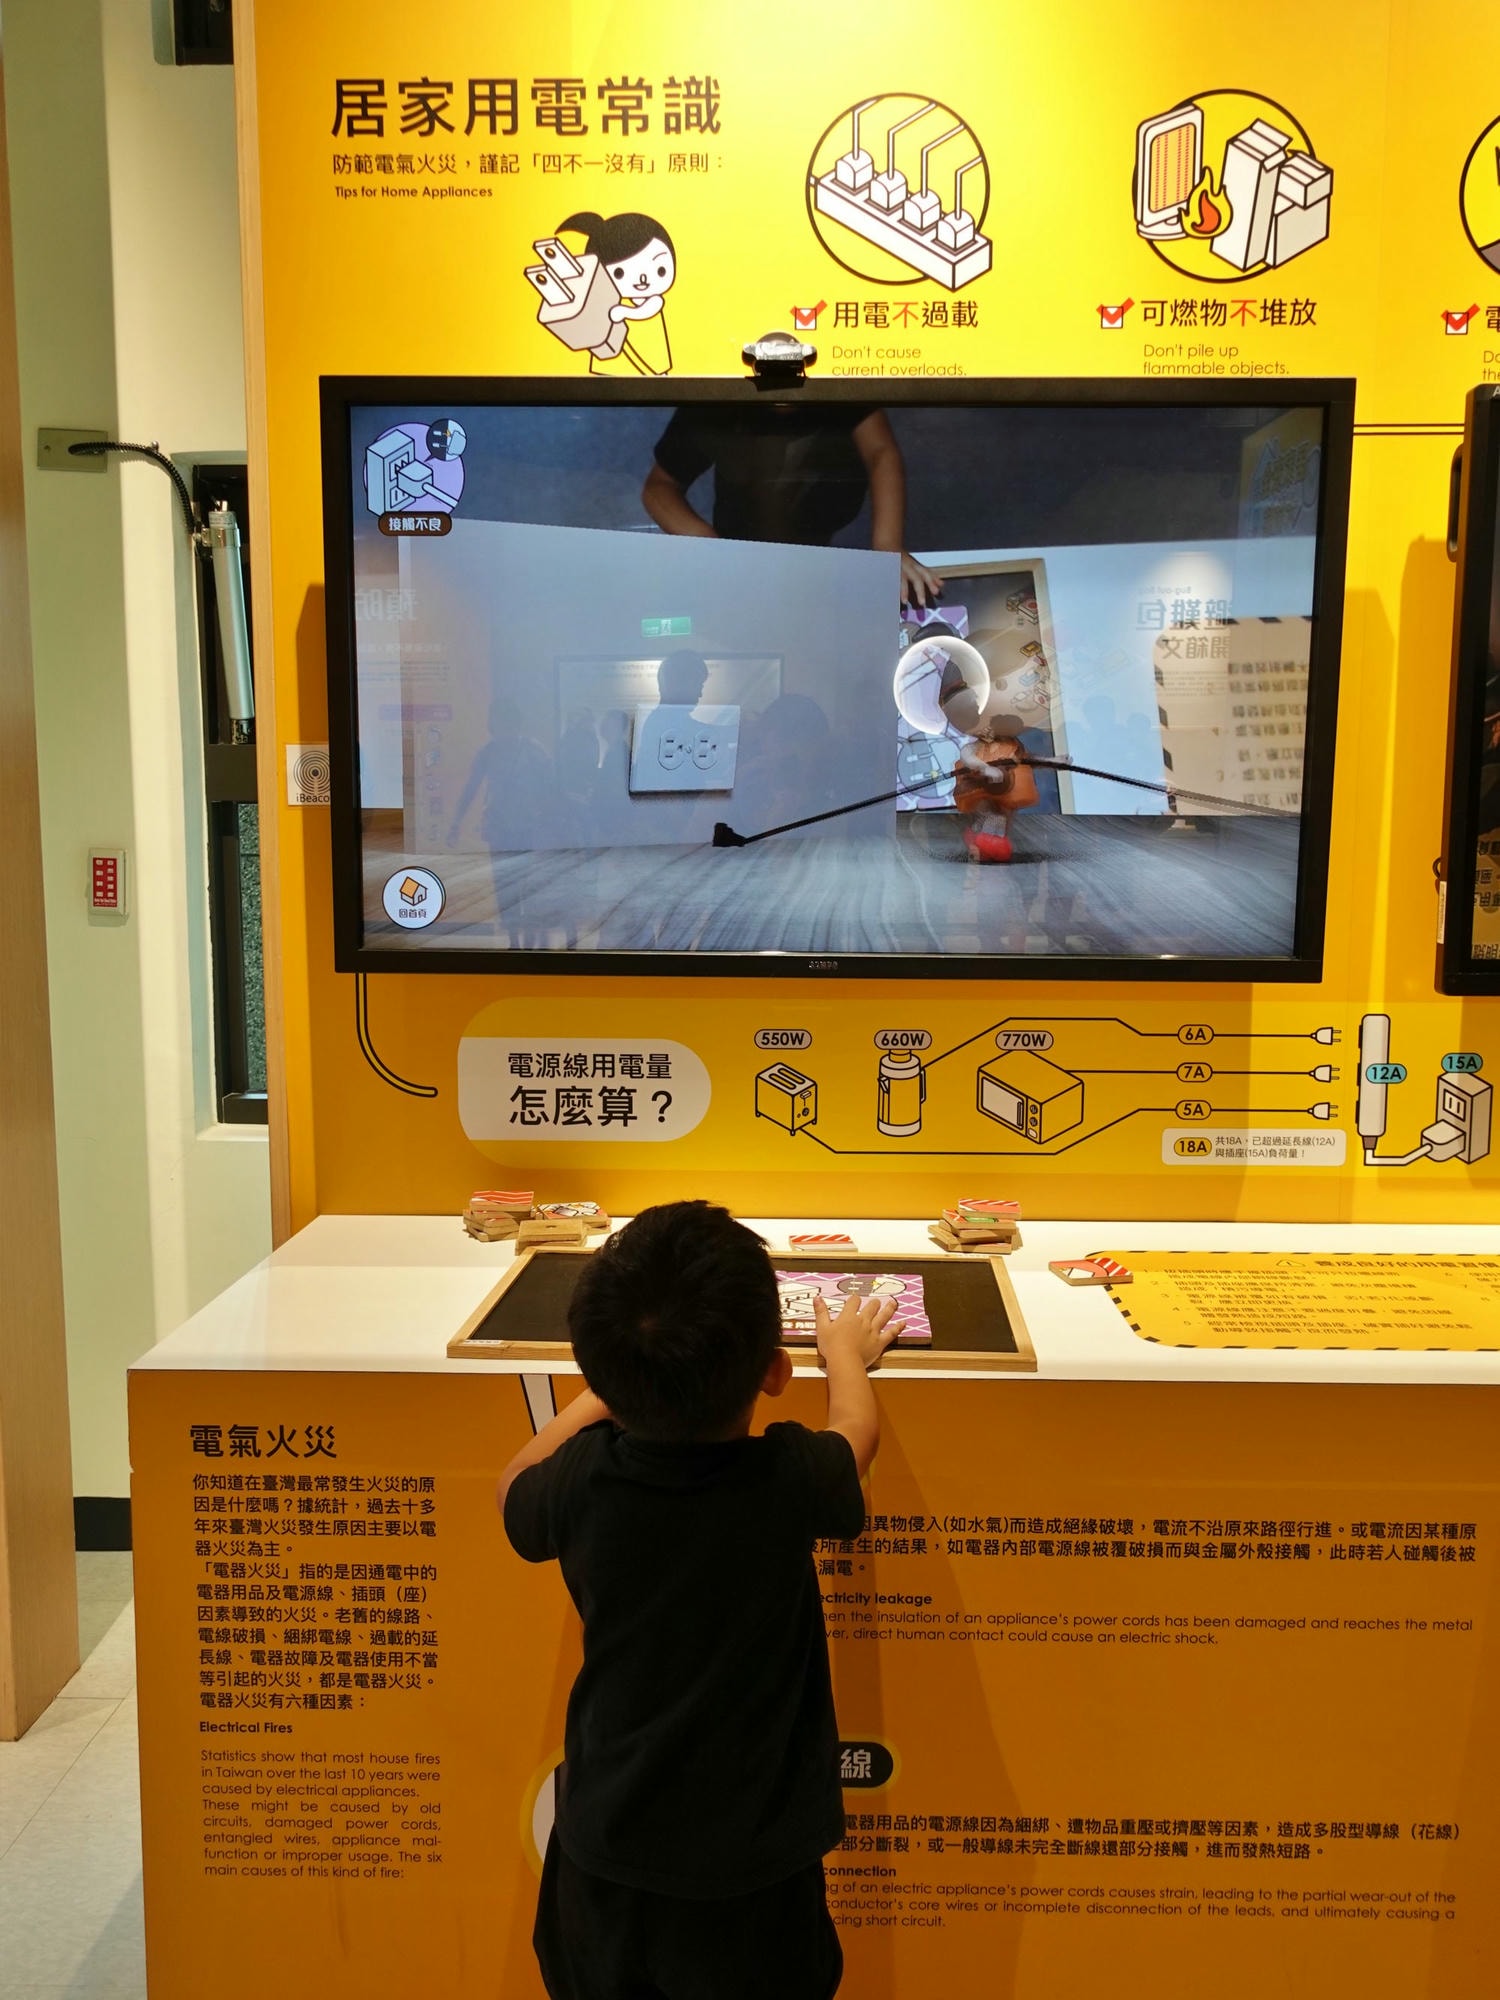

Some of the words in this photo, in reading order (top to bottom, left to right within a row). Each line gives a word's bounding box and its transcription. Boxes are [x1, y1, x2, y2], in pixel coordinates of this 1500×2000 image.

[331, 75, 721, 138] 居家用電常識
[332, 153, 723, 176] 防範電氣火災，謹記「四不一沒有」原則：
[335, 186, 358, 199] Tips
[361, 186, 377, 197] for
[381, 186, 418, 197] Home
[422, 186, 492, 200] Appliances
[833, 300, 979, 329] 用電不過載
[1141, 298, 1317, 327] 可燃物不堆放
[833, 345, 870, 359] Don't
[876, 348, 921, 359] cause
[1144, 344, 1183, 357] Don't
[1188, 344, 1214, 359] pile
[1219, 347, 1238, 359] up
[832, 364, 885, 376] current
[890, 364, 966, 376] overloads.
[1144, 361, 1225, 375] flammable
[1230, 361, 1289, 377] objects.
[388, 517, 441, 531] 接觸不良
[399, 908, 427, 918] 回首頁
[761, 1032, 804, 1046] 550W
[881, 1033, 924, 1047] 660W
[1003, 1034, 1046, 1047] 770W
[1185, 1028, 1207, 1041] 6A
[507, 1053, 672, 1080] 電源線用電量
[1446, 1056, 1478, 1069] 15A
[1184, 1066, 1205, 1079] 7A
[1371, 1067, 1402, 1080] 12A
[509, 1085, 674, 1127] 怎麼算？
[1183, 1104, 1204, 1117] 5A
[1179, 1141, 1208, 1153] 18A
[190, 1424, 337, 1458] 電氣火災
[193, 1474, 435, 1493] 你知道在臺灣最常發生火災的原
[194, 1496, 435, 1514] 因是什麼嗎？據統計，過去十多
[194, 1518, 436, 1537] 年來臺灣火災發生原因主要以電
[195, 1541, 293, 1557] 器火災為主。
[204, 1562, 437, 1581] 「電器火災」指的是因通電中的
[197, 1584, 428, 1603] 電器用品及電源線、插頭（座）
[874, 1592, 933, 1607] leakage
[198, 1606, 432, 1624] 因素導致的火災。老舊的線路、
[850, 1611, 873, 1623] the
[877, 1611, 940, 1623] insulation
[945, 1612, 959, 1624] of
[964, 1615, 982, 1624] an
[1073, 1616, 1117, 1629] power
[1122, 1614, 1160, 1626] cords
[1165, 1615, 1189, 1627] has
[1193, 1615, 1230, 1627] been
[1235, 1616, 1306, 1632] damaged
[1311, 1617, 1339, 1629] and
[1344, 1617, 1399, 1630] reaches
[1405, 1618, 1427, 1630] the
[1432, 1618, 1473, 1631] metal
[198, 1628, 438, 1646] 電線破損、綑綁電線、過載的延
[853, 1628, 892, 1640] direct
[896, 1629, 945, 1641] human
[949, 1629, 1004, 1642] contact
[1008, 1630, 1047, 1642] could
[1051, 1633, 1093, 1643] cause
[1097, 1634, 1115, 1643] an
[1120, 1631, 1171, 1644] electric
[1175, 1632, 1218, 1644] shock.
[199, 1650, 438, 1668] 長線、電器故障及電器使用不當
[200, 1671, 434, 1689] 等引起的火災，都是電器火災。
[200, 1693, 365, 1710] 電器火災有六種因素：
[200, 1721, 260, 1733] Electrical
[264, 1722, 292, 1733] Fires
[200, 1750, 256, 1762] Statistics
[260, 1750, 295, 1762] show
[300, 1751, 327, 1763] that
[332, 1752, 364, 1763] most
[369, 1752, 409, 1764] house
[415, 1753, 440, 1765] fires
[841, 1749, 871, 1779] 線
[201, 1766, 213, 1778] in
[216, 1766, 263, 1778] Taiwan
[266, 1770, 296, 1779] over
[300, 1767, 320, 1779] the
[324, 1768, 346, 1779] last
[351, 1768, 365, 1780] 10
[368, 1771, 404, 1784] years
[407, 1772, 440, 1781] were
[202, 1782, 251, 1795] caused
[256, 1783, 272, 1798] by
[276, 1784, 338, 1796] electrical
[342, 1784, 419, 1800] appliances.
[203, 1799, 240, 1811] These
[251, 1800, 288, 1815] might
[300, 1800, 318, 1812] be
[330, 1801, 380, 1813] caused
[392, 1802, 409, 1817] by
[420, 1802, 441, 1814] old
[203, 1815, 252, 1829] circuits,
[264, 1816, 333, 1832] damaged
[346, 1820, 389, 1833] power
[401, 1818, 441, 1831] cords,
[204, 1832, 272, 1848] entangled
[284, 1833, 320, 1846] wires,
[332, 1834, 400, 1849] appliance
[412, 1835, 441, 1846] mal-
[833, 1836, 1323, 1859] 部分斷裂，或一般導線未完全斷線還部分接觸，進而發熱短路。
[204, 1848, 258, 1860] function
[264, 1852, 277, 1861] or
[282, 1849, 343, 1865] improper
[348, 1853, 392, 1865] usage.
[398, 1851, 422, 1862] The
[427, 1851, 442, 1863] six
[205, 1864, 237, 1876] main
[241, 1867, 287, 1877] causes
[290, 1865, 304, 1877] of
[308, 1865, 329, 1877] this
[333, 1865, 359, 1877] kind
[363, 1866, 376, 1877] of
[380, 1866, 404, 1878] fire:
[842, 1882, 856, 1894] of
[860, 1885, 878, 1894] an
[882, 1882, 932, 1895] electric
[936, 1883, 1016, 1900] appliance's
[1020, 1887, 1063, 1900] power
[1067, 1885, 1105, 1897] cords
[1109, 1889, 1156, 1898] causes
[1159, 1887, 1198, 1900] strain,
[1202, 1887, 1254, 1903] leading
[1259, 1888, 1272, 1900] to
[1277, 1888, 1299, 1900] the
[1303, 1889, 1346, 1905] partial
[1350, 1889, 1411, 1902] wear-out
[1415, 1890, 1430, 1902] of
[1434, 1891, 1455, 1903] the
[909, 1902, 939, 1911] core
[945, 1900, 979, 1912] wires
[984, 1903, 997, 1912] or
[1003, 1901, 1080, 1917] incomplete
[1086, 1902, 1182, 1915] disconnection
[1188, 1904, 1201, 1915] of
[1208, 1904, 1229, 1916] the
[1235, 1904, 1275, 1918] leads,
[1281, 1905, 1308, 1917] and
[1314, 1906, 1380, 1922] ultimately
[1386, 1907, 1439, 1923] causing
[1445, 1910, 1454, 1920] a
[865, 1914, 897, 1926] short
[901, 1915, 946, 1927] circuit.
